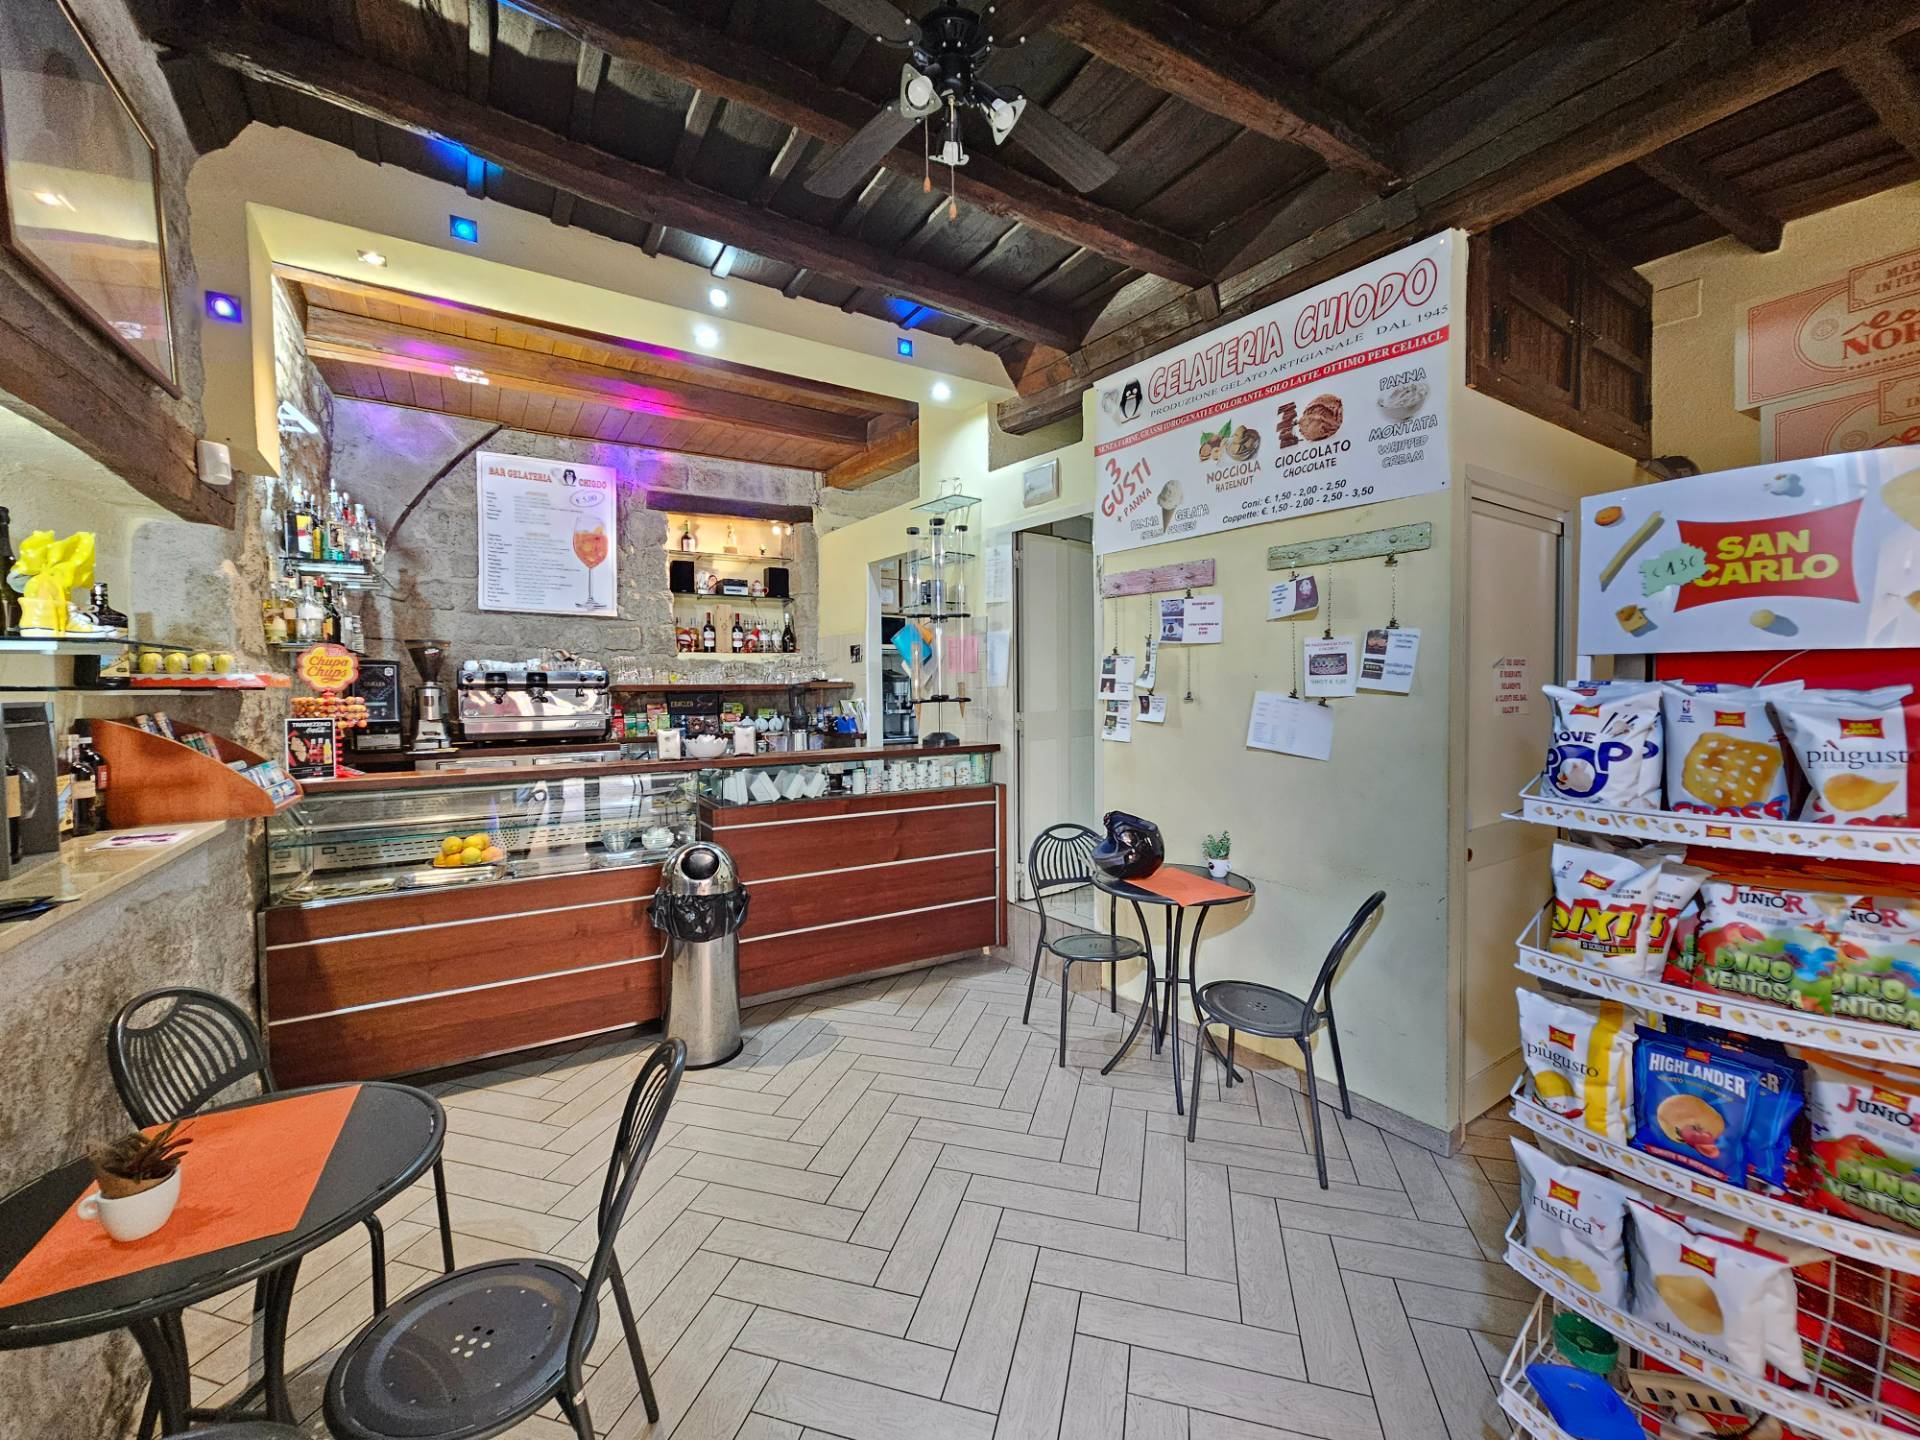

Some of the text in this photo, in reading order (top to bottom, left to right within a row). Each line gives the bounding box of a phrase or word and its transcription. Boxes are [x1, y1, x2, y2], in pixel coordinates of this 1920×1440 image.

[1148, 258, 1438, 404] GELATERIA CHIODO
[1150, 303, 1449, 417] PRODUZIONE GELATO ARTIGIANALE DAL 1945
[1265, 380, 1288, 395] SOLO
[1323, 354, 1365, 374] OTTIMO
[1367, 347, 1390, 361] PER
[1380, 367, 1426, 391] PANNA
[1369, 414, 1438, 442] MONTATA
[1275, 439, 1351, 469] CIOCCOLATO
[1378, 434, 1429, 455] WHIPPED
[1382, 450, 1424, 469] CREAM
[488, 466, 607, 489] BAR GELATERIA CHIODO
[1105, 457, 1121, 485] 3
[1206, 460, 1262, 484] NOCCIOLA
[1283, 457, 1337, 478] CHOCOLATE
[1101, 456, 1151, 518] GUSTI
[1215, 475, 1254, 493] HAZELNUT
[1241, 498, 1263, 510] Coni:
[1275, 491, 1291, 503] 1,50
[1299, 485, 1317, 498] 2,00
[1326, 479, 1347, 492] 2,50
[1123, 487, 1152, 518] PANNA
[1175, 503, 1210, 522] GELATA
[1222, 509, 1260, 524] Coppette:
[1271, 502, 1288, 514] 1,50
[1295, 497, 1314, 509] 2,00
[1322, 492, 1343, 504] 2,50
[1351, 486, 1374, 498] 3,50
[1716, 529, 1810, 561] SAN
[1693, 553, 1840, 588] CARLO
[306, 666, 348, 680] Chups
[308, 655, 350, 668] Chupa
[1721, 884, 1807, 916] JUNIOR
[1715, 949, 1793, 983] DINO
[1648, 1052, 1746, 1099] HIGHLANDER
[1533, 1196, 1593, 1235] rustica
[1655, 1321, 1729, 1363] classica
